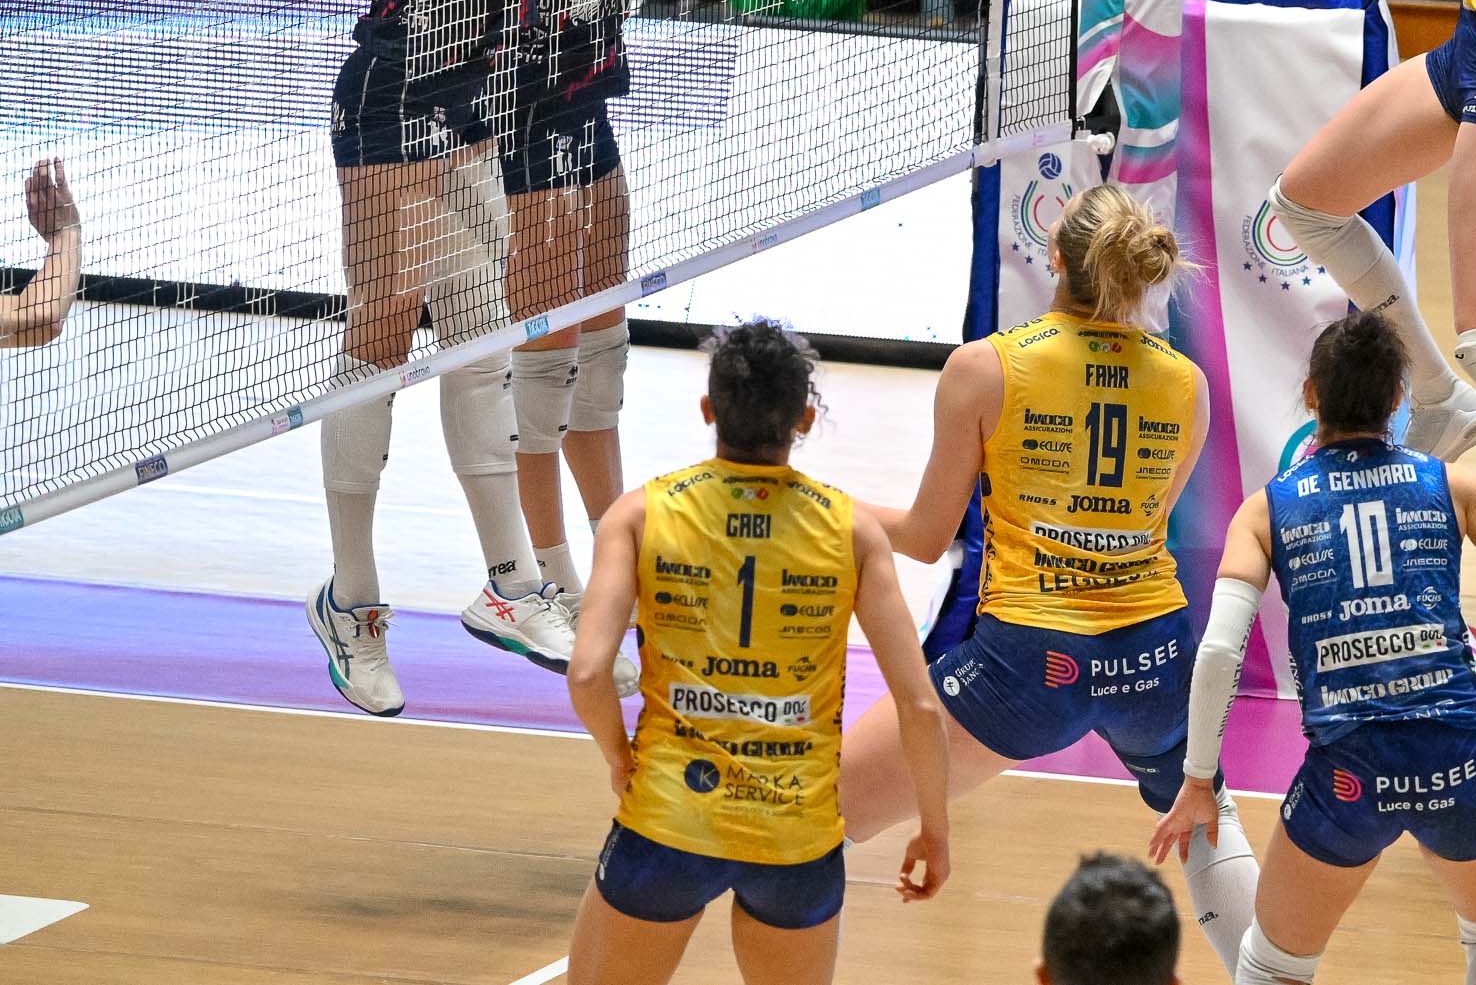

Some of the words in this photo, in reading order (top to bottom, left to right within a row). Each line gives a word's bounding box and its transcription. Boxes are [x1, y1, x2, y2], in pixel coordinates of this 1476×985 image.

[1271, 264, 1309, 278] ITALIANA
[1085, 363, 1130, 390] FAHR
[1024, 425, 1074, 435] ASSICURAZIONI
[1039, 439, 1073, 454] ECLISSE
[1085, 402, 1128, 489] 19
[1020, 456, 1070, 469] OMODA
[1297, 474, 1321, 498] DE
[1328, 463, 1418, 492] GENNARO
[1018, 493, 1057, 507] RHOSS
[1067, 493, 1132, 515] Joma
[726, 513, 772, 539] GABI
[1339, 500, 1394, 590] 10
[1418, 539, 1448, 552] ECLISSE
[1300, 548, 1335, 568] ECLISSE
[737, 556, 756, 648] 1
[1339, 594, 1412, 622] Joma
[1416, 592, 1443, 603] FUCHS
[1091, 639, 1180, 678] PULSEE
[1320, 631, 1416, 667] PROSECCO
[702, 655, 780, 679] Joma
[1091, 684, 1118, 698] Luce
[1122, 684, 1130, 694] e
[1135, 678, 1160, 692] Gas
[672, 687, 778, 722] PROSECCO
[1378, 800, 1411, 813] Luce
[1415, 801, 1424, 811] e
[1428, 797, 1456, 811] Gas
